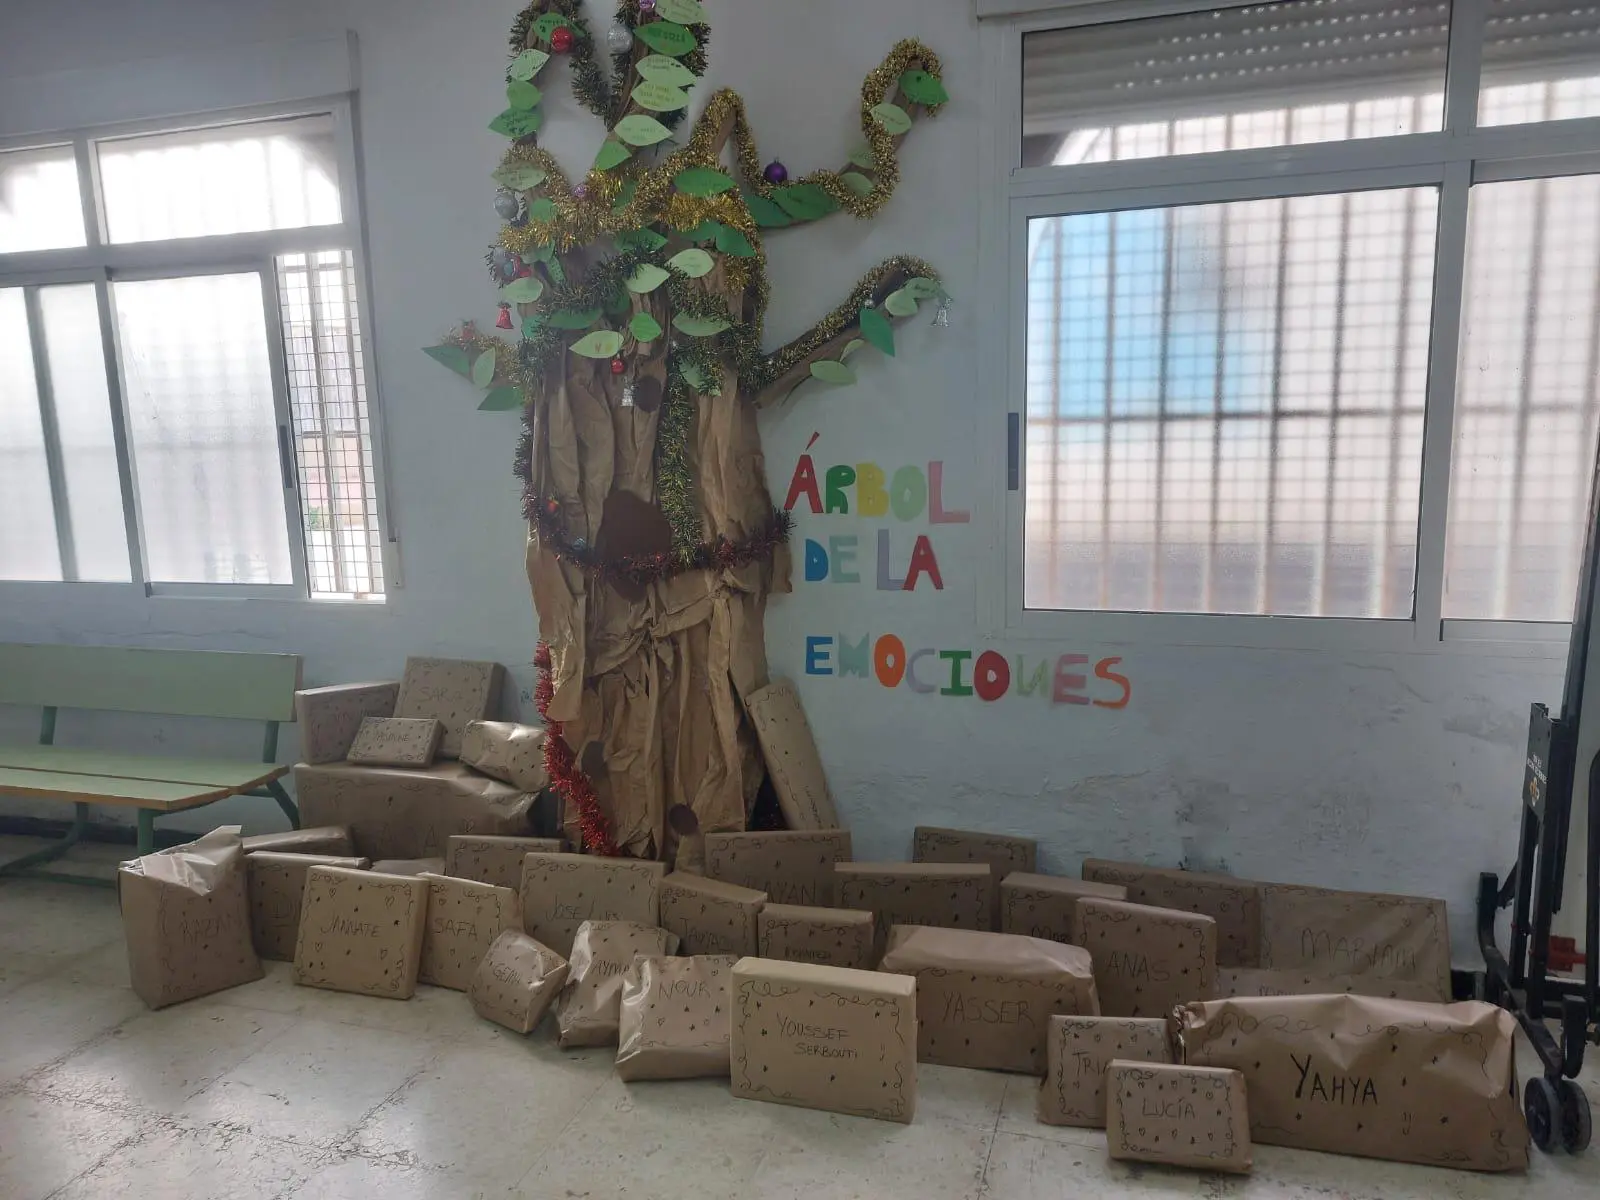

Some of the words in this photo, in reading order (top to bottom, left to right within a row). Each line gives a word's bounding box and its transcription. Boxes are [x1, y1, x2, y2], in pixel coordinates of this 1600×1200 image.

[783, 431, 970, 524] ÁRBOL
[804, 535, 861, 584] DE
[876, 528, 944, 592] LA
[805, 631, 1132, 710] EMOCIONES
[431, 918, 479, 942] SAFA
[1104, 950, 1171, 983] ANAS
[658, 980, 711, 999] NOUR
[942, 990, 1036, 1028] YASSER
[1289, 1052, 1379, 1106] YAHYA
[1141, 1096, 1196, 1120] LUCÍA
